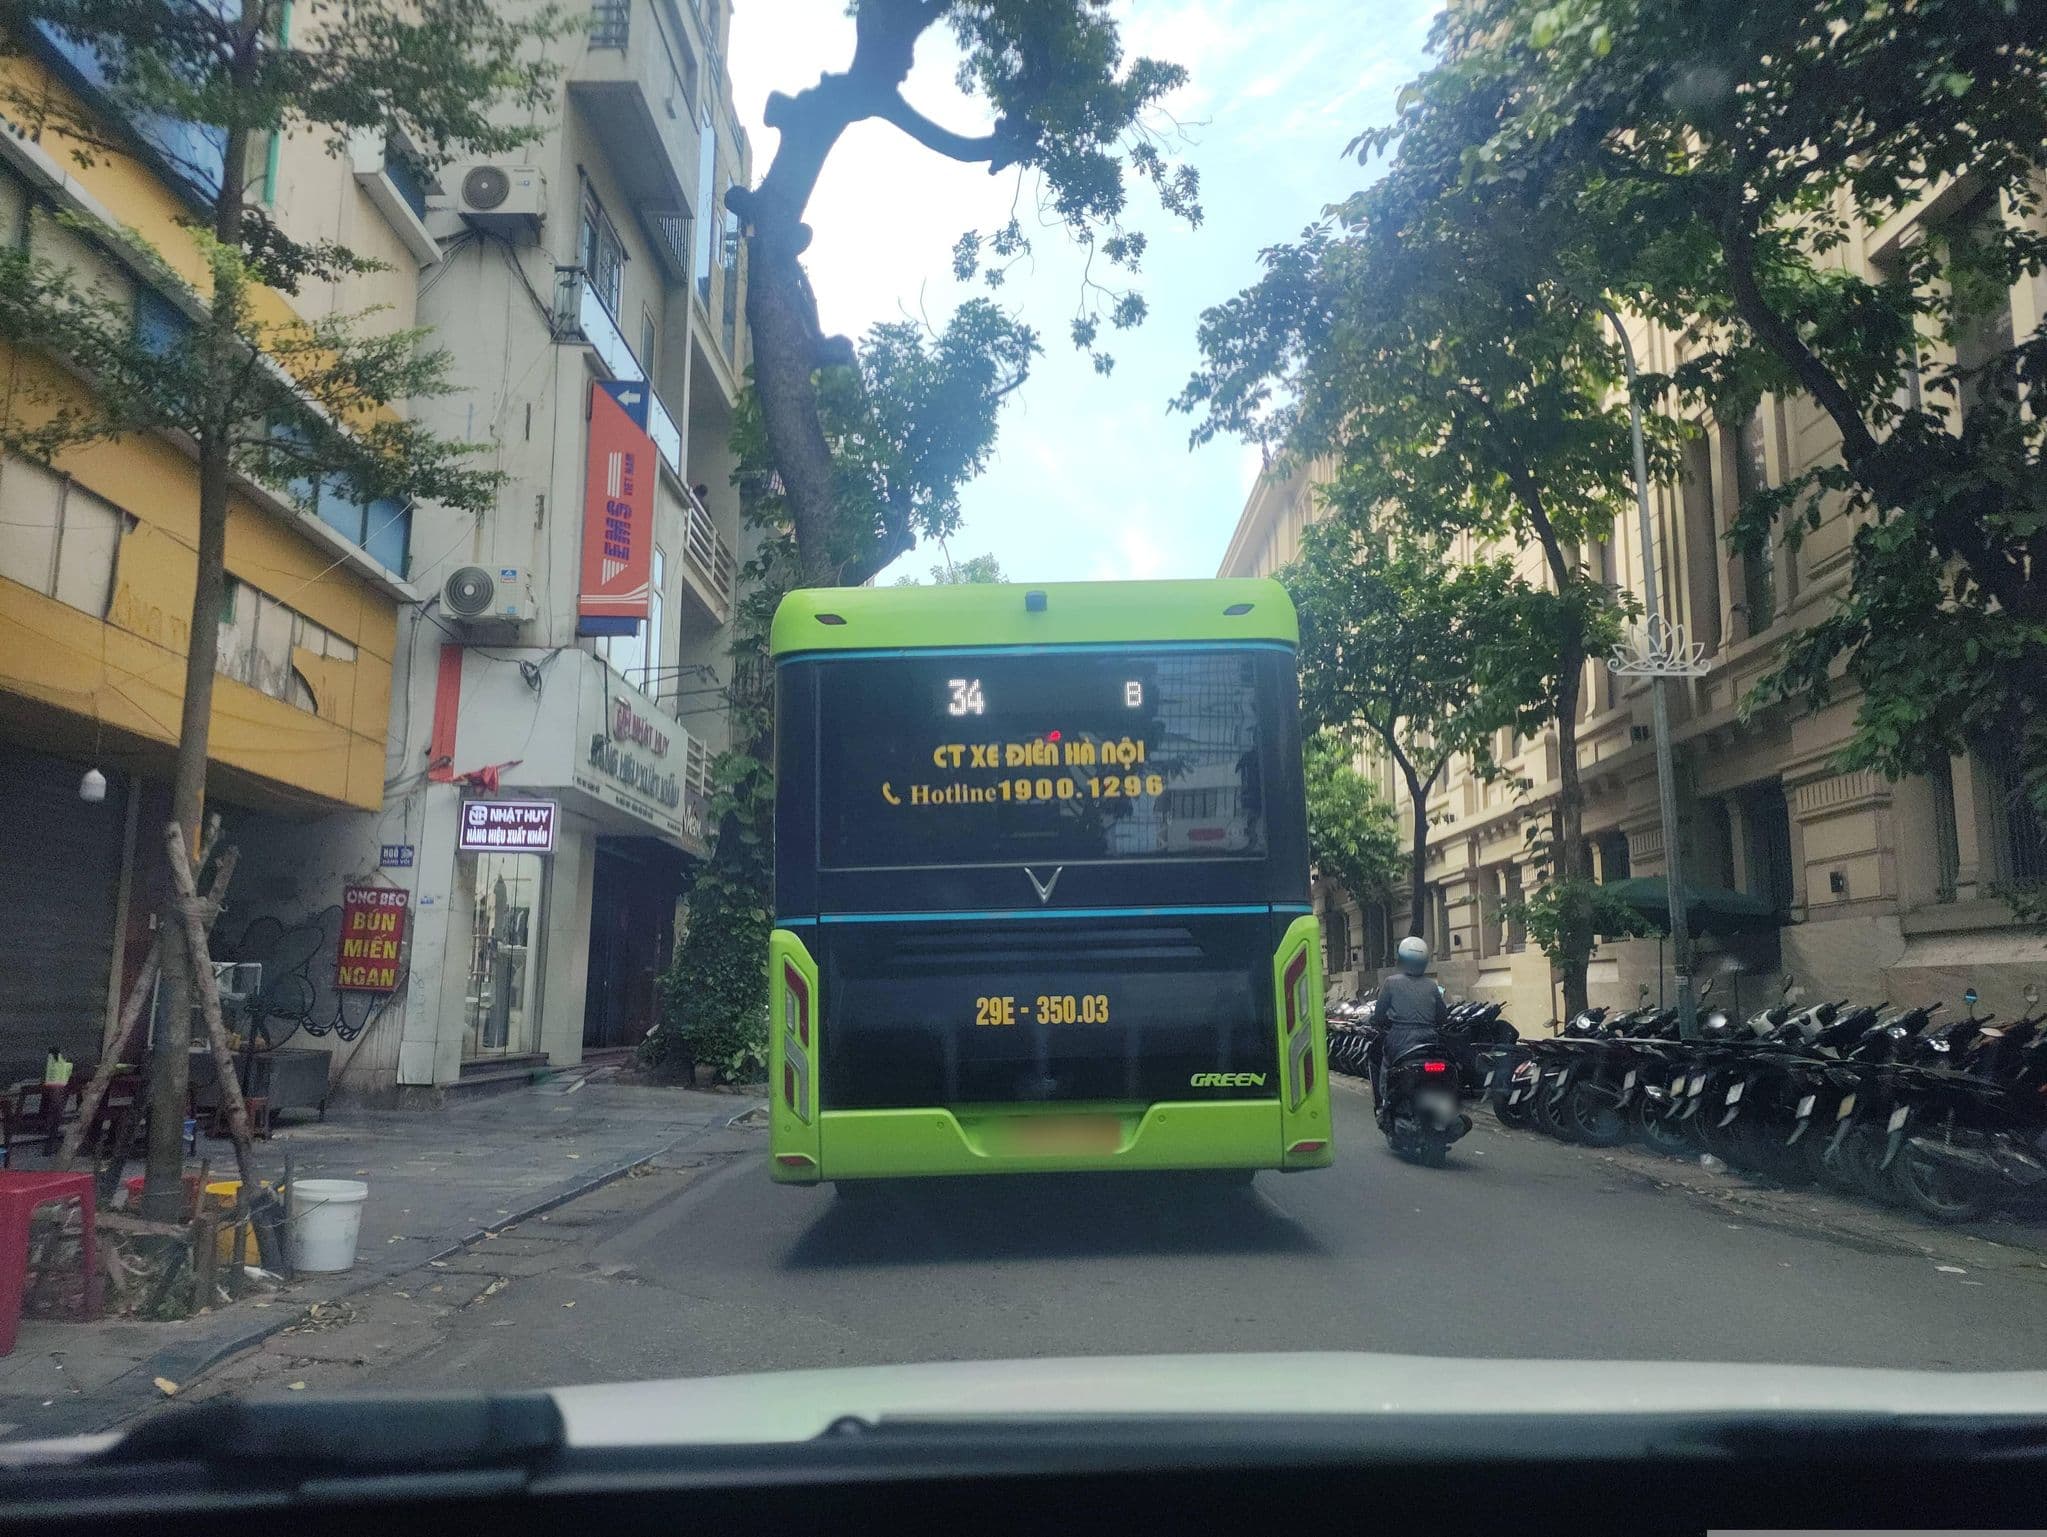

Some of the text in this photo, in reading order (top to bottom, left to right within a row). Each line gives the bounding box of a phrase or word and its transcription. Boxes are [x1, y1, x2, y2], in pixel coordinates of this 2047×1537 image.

[603, 500, 632, 561] EMS
[948, 679, 1142, 715] 34 B
[933, 745, 966, 769] CT
[970, 744, 999, 768] XE
[1065, 737, 1096, 765] HÀ
[1101, 735, 1145, 770] NỘI
[911, 774, 1164, 806] Hotline 1900.1296
[490, 806, 523, 825] NHẬT
[524, 809, 549, 823] HUY
[506, 825, 527, 844] XUẤT
[353, 908, 397, 932] BÚN
[338, 966, 395, 986] NGAN
[976, 996, 1016, 1026] 29E
[1036, 994, 1109, 1025] 350.03
[1190, 1072, 1266, 1087] GREEN
